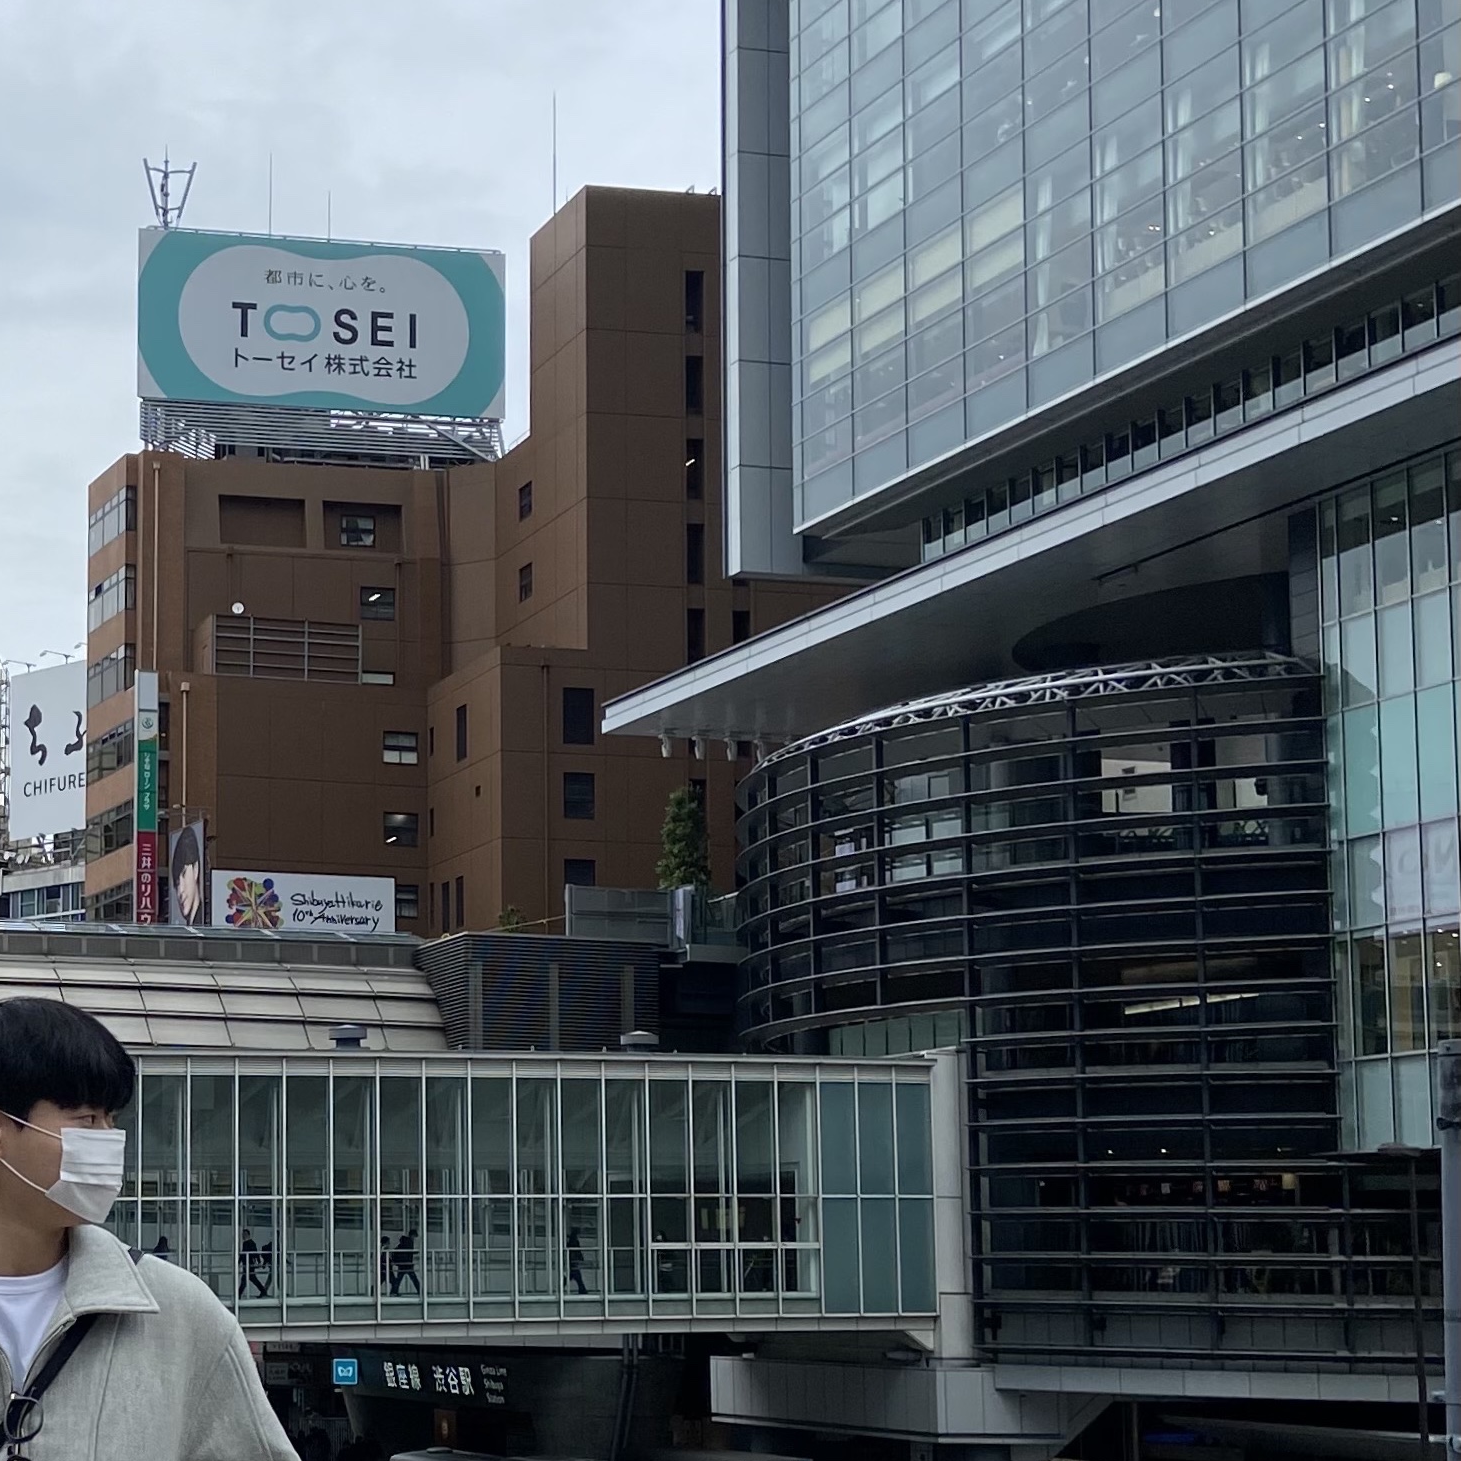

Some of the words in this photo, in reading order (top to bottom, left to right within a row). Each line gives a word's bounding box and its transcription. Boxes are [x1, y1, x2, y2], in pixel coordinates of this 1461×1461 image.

[264, 269, 386, 293] 都市に、心を。
[232, 302, 418, 349] TOSEI
[234, 347, 418, 380] トーセイ株式会社
[24, 772, 86, 797] CHIFURE
[310, 913, 379, 933] Anniversary
[383, 1361, 422, 1391] 銀座線
[432, 1365, 475, 1396] 渋谷駅
